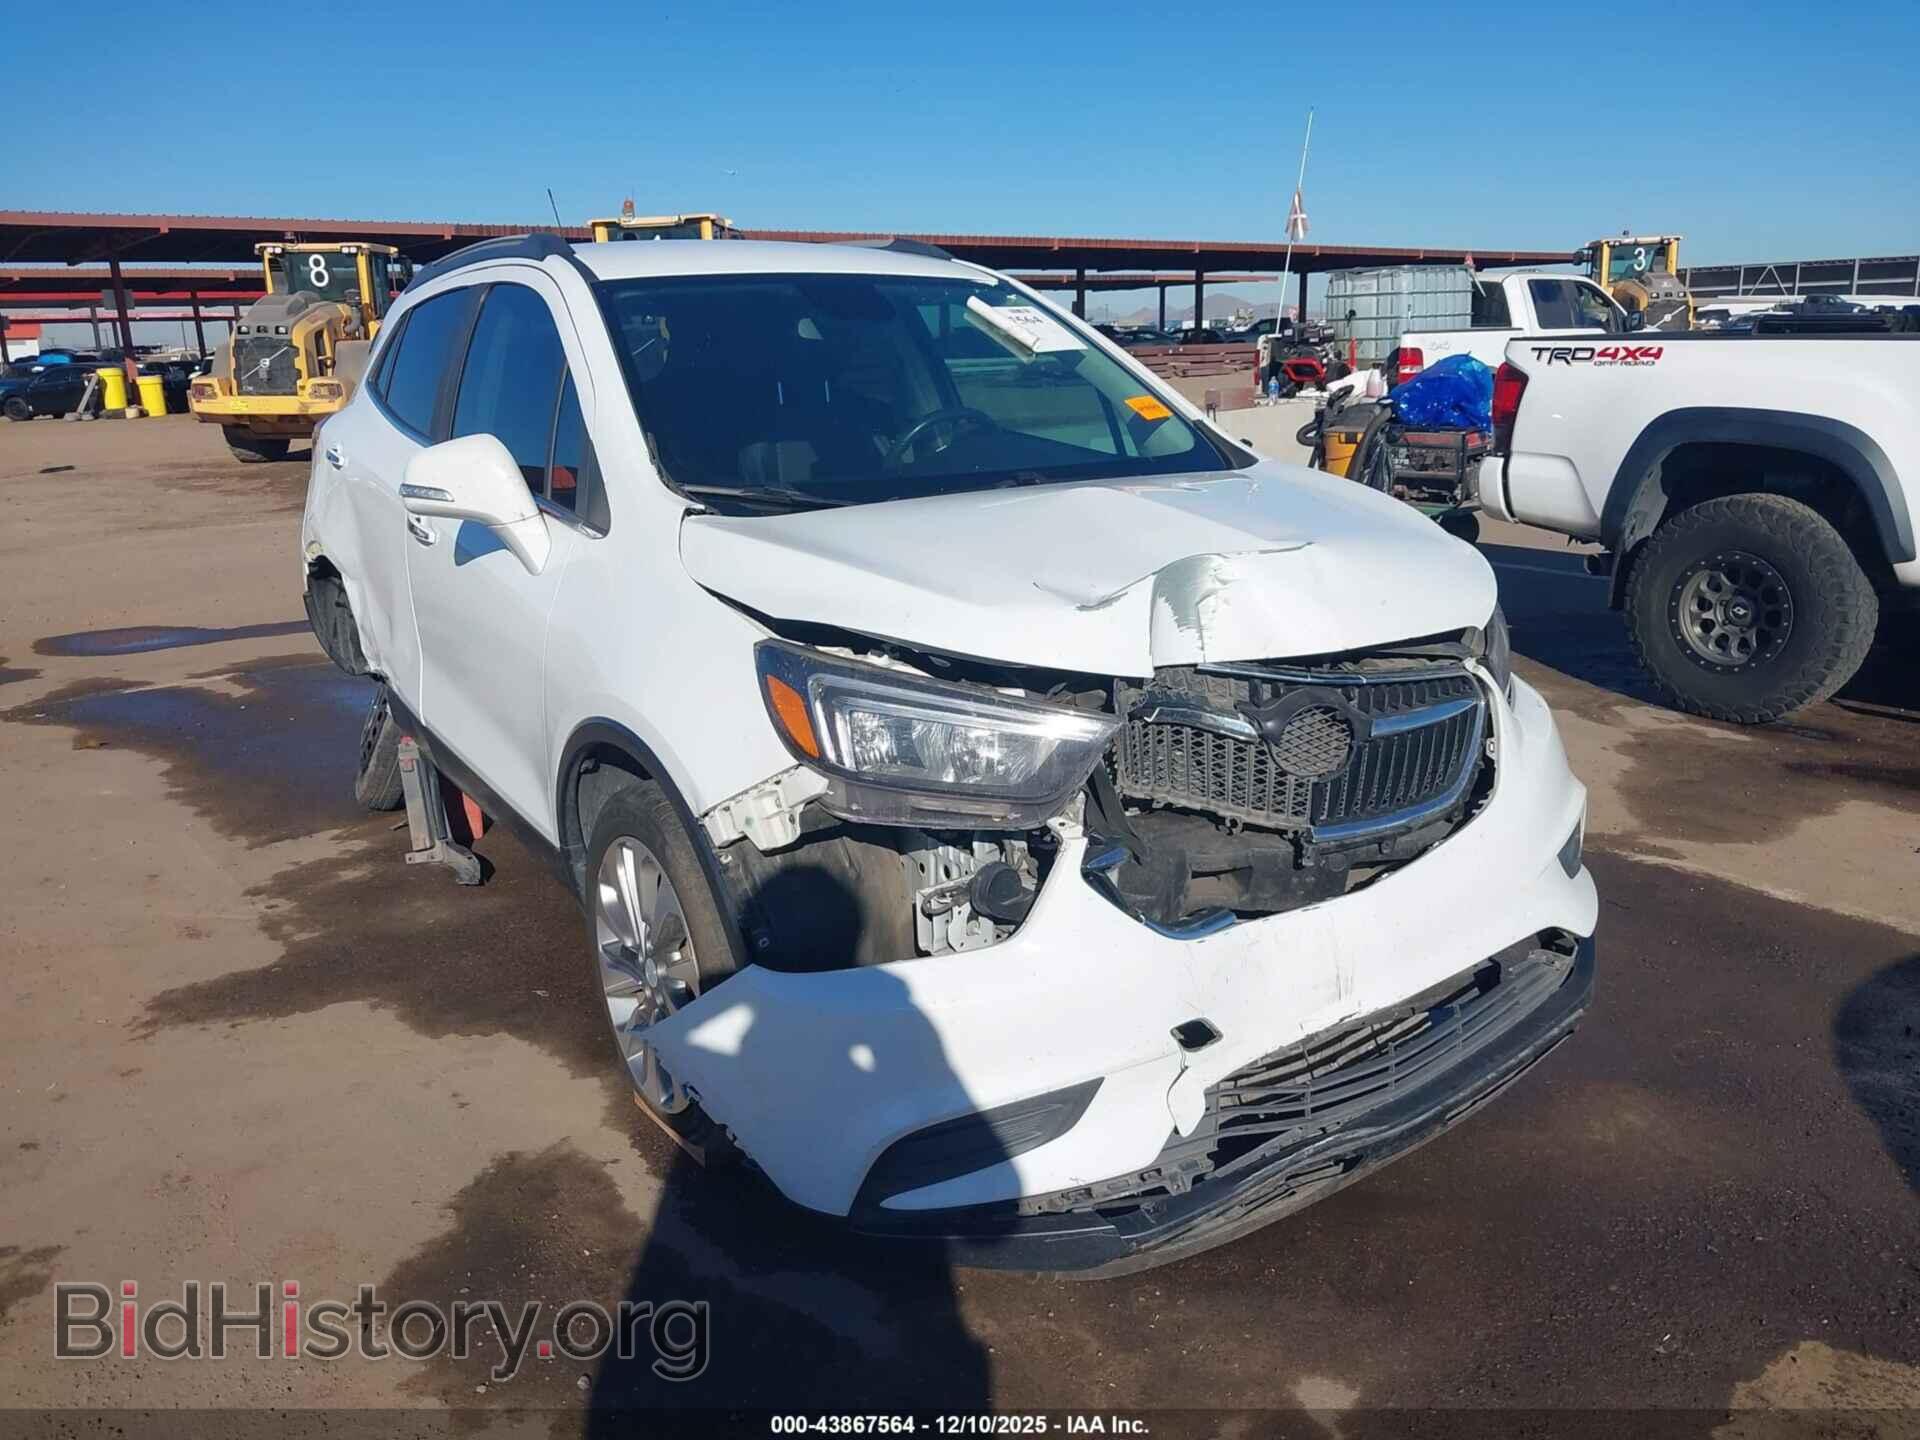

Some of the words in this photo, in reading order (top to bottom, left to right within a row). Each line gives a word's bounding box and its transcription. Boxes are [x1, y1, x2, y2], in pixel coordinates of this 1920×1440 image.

[308, 254, 329, 288] 8
[1633, 247, 1646, 271] 3
[1530, 347, 1595, 366] TRD
